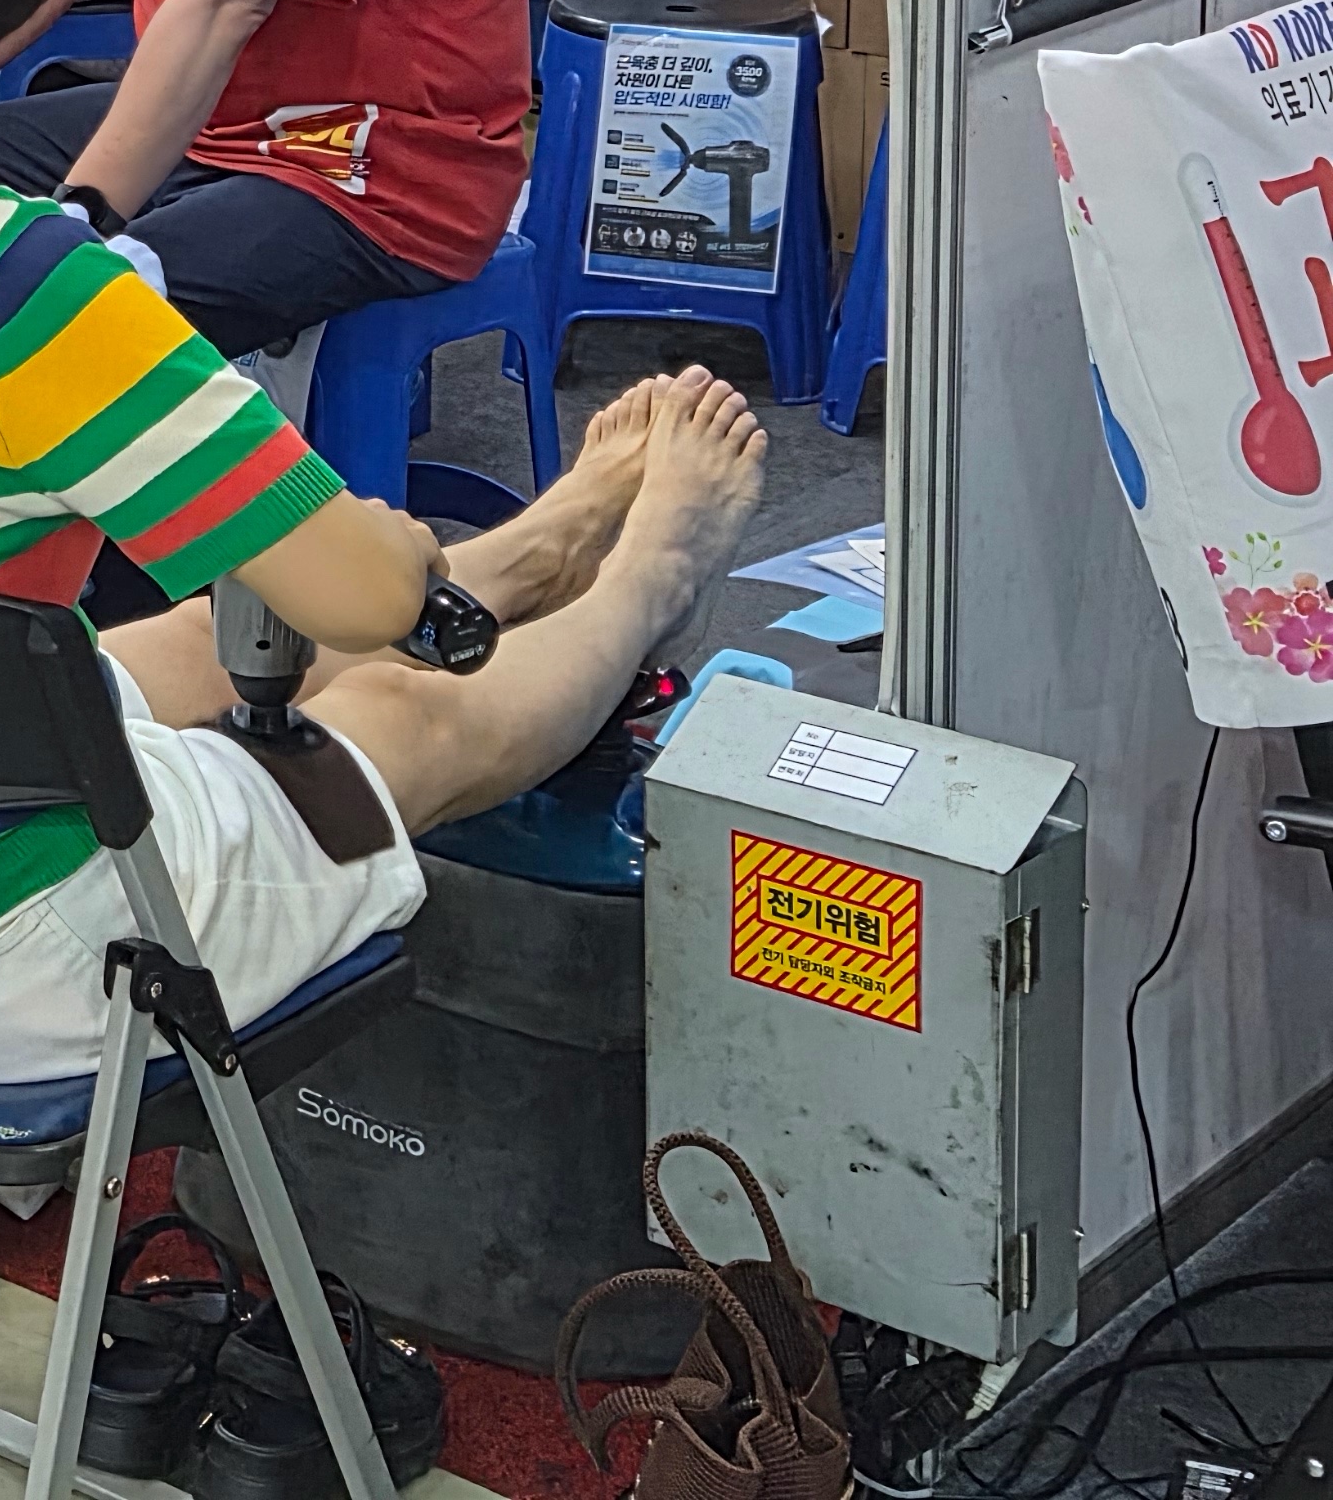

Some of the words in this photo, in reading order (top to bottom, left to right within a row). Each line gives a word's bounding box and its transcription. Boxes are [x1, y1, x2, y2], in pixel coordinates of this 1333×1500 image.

[767, 887, 882, 948] 전기위험
[761, 947, 784, 965] 전기
[839, 970, 887, 996] 조작금지
